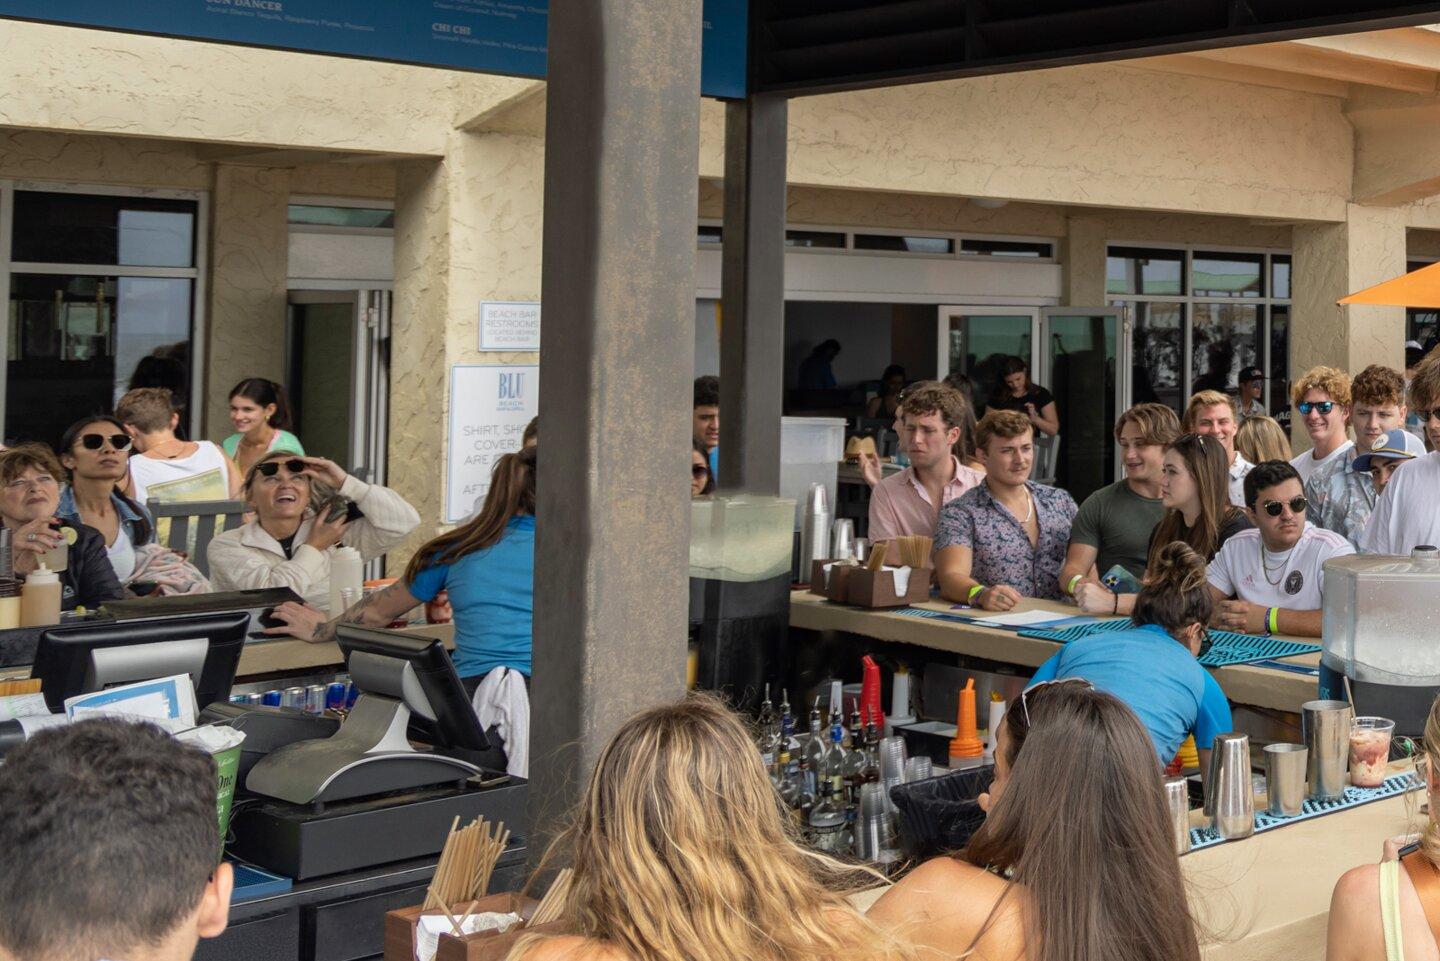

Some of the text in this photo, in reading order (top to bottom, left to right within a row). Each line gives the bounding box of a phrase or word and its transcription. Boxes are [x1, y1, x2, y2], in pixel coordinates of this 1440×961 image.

[432, 22, 472, 36] CHI CHI
[488, 310, 537, 319] BEACH BAR
[485, 320, 538, 328] RESTROOMS
[498, 372, 526, 399] BLU
[463, 425, 500, 438] SHIRT,
[464, 455, 489, 465] ARE
